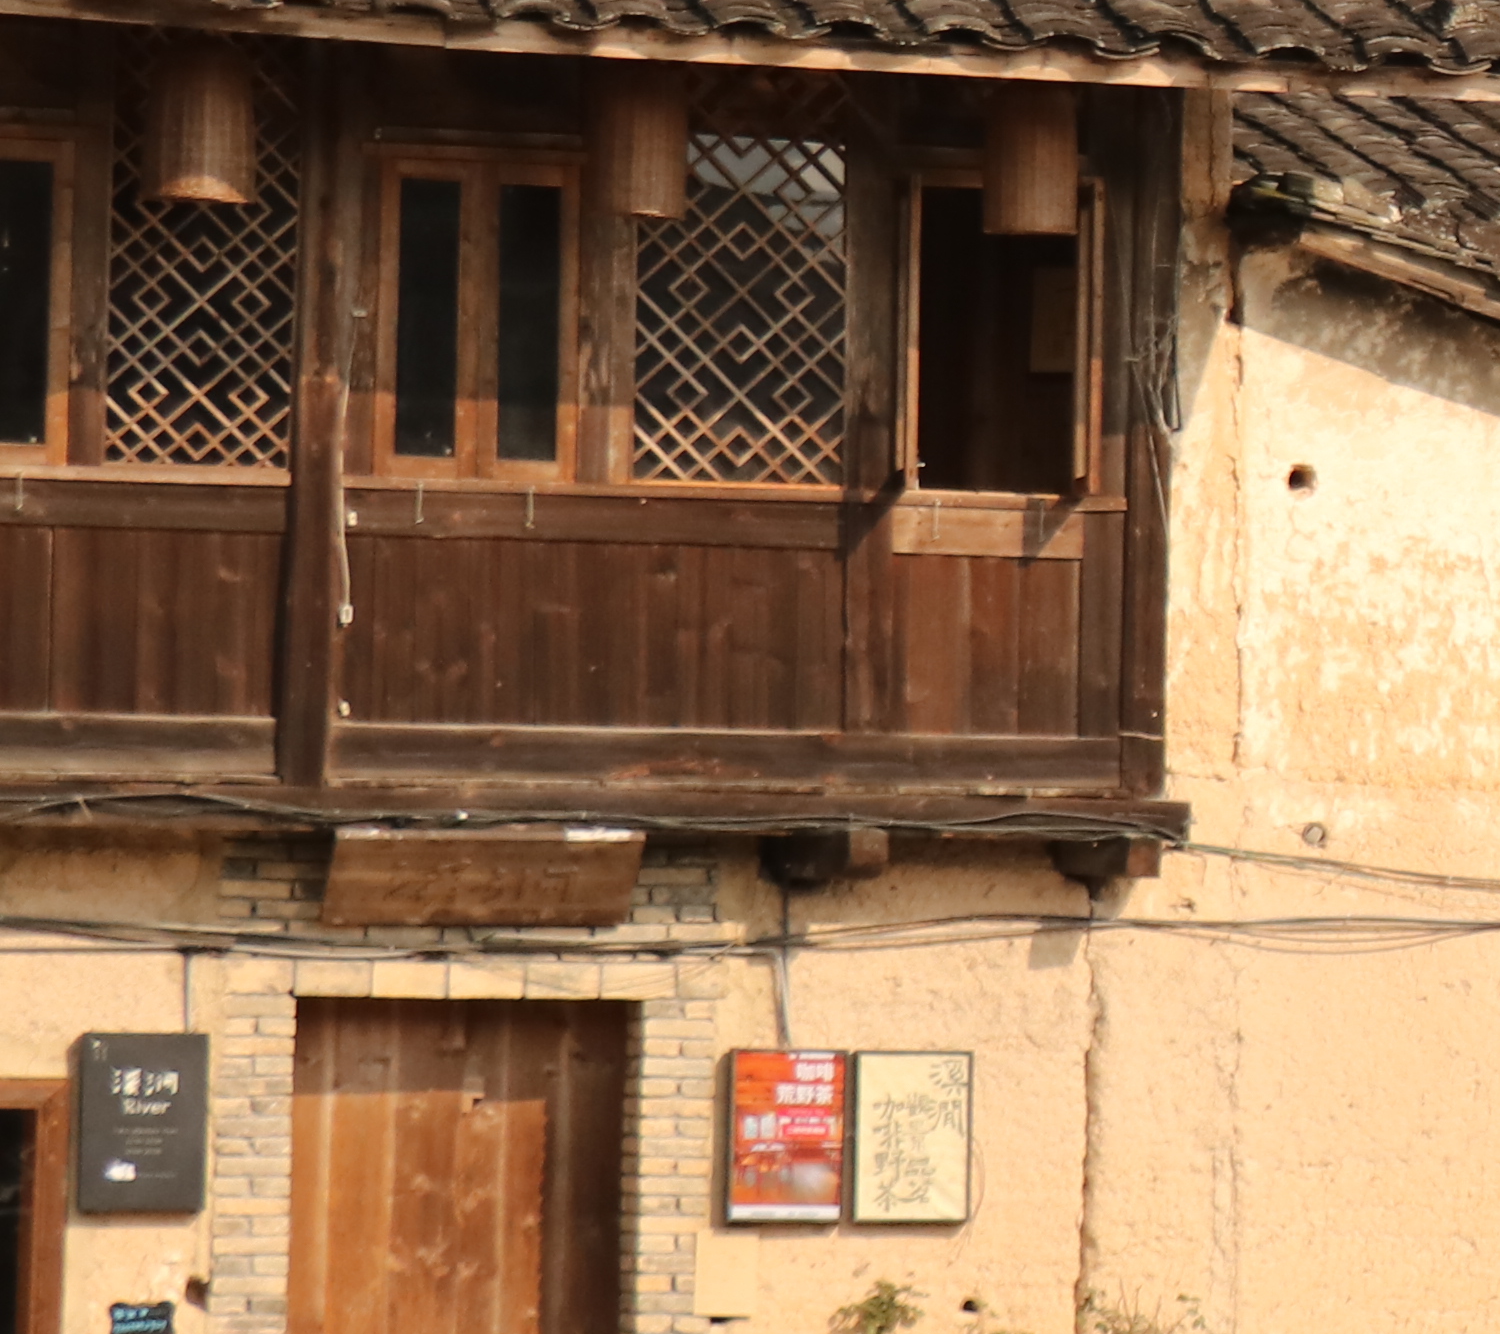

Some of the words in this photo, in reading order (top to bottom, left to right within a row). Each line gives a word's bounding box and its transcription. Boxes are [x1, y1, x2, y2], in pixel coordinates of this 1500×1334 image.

[795, 1062, 835, 1082] 咖啡
[775, 1084, 834, 1105] 荒野茶
[123, 1099, 172, 1115] River
